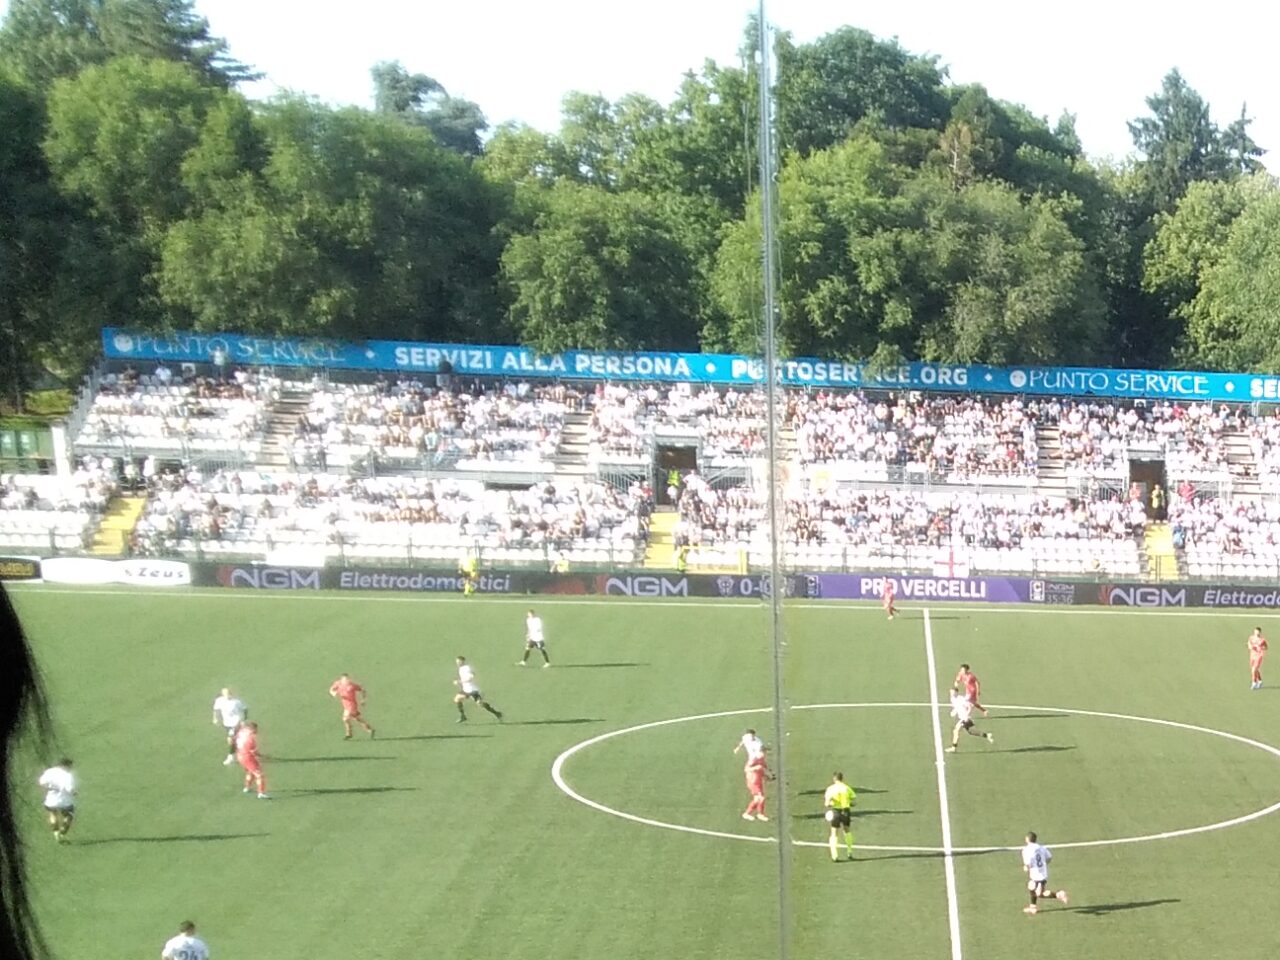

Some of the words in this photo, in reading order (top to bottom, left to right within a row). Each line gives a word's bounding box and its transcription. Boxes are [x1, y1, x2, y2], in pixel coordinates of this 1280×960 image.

[395, 346, 492, 370] SERVIZI
[502, 350, 566, 372] ALLA
[576, 354, 691, 376] PERSONA
[1029, 370, 1109, 391] PUNTO
[1114, 373, 1210, 395] SERVICE
[231, 567, 320, 589] NGM
[606, 577, 688, 597] NGM
[901, 579, 986, 599] VERCELLI
[1109, 587, 1186, 607] NGM
